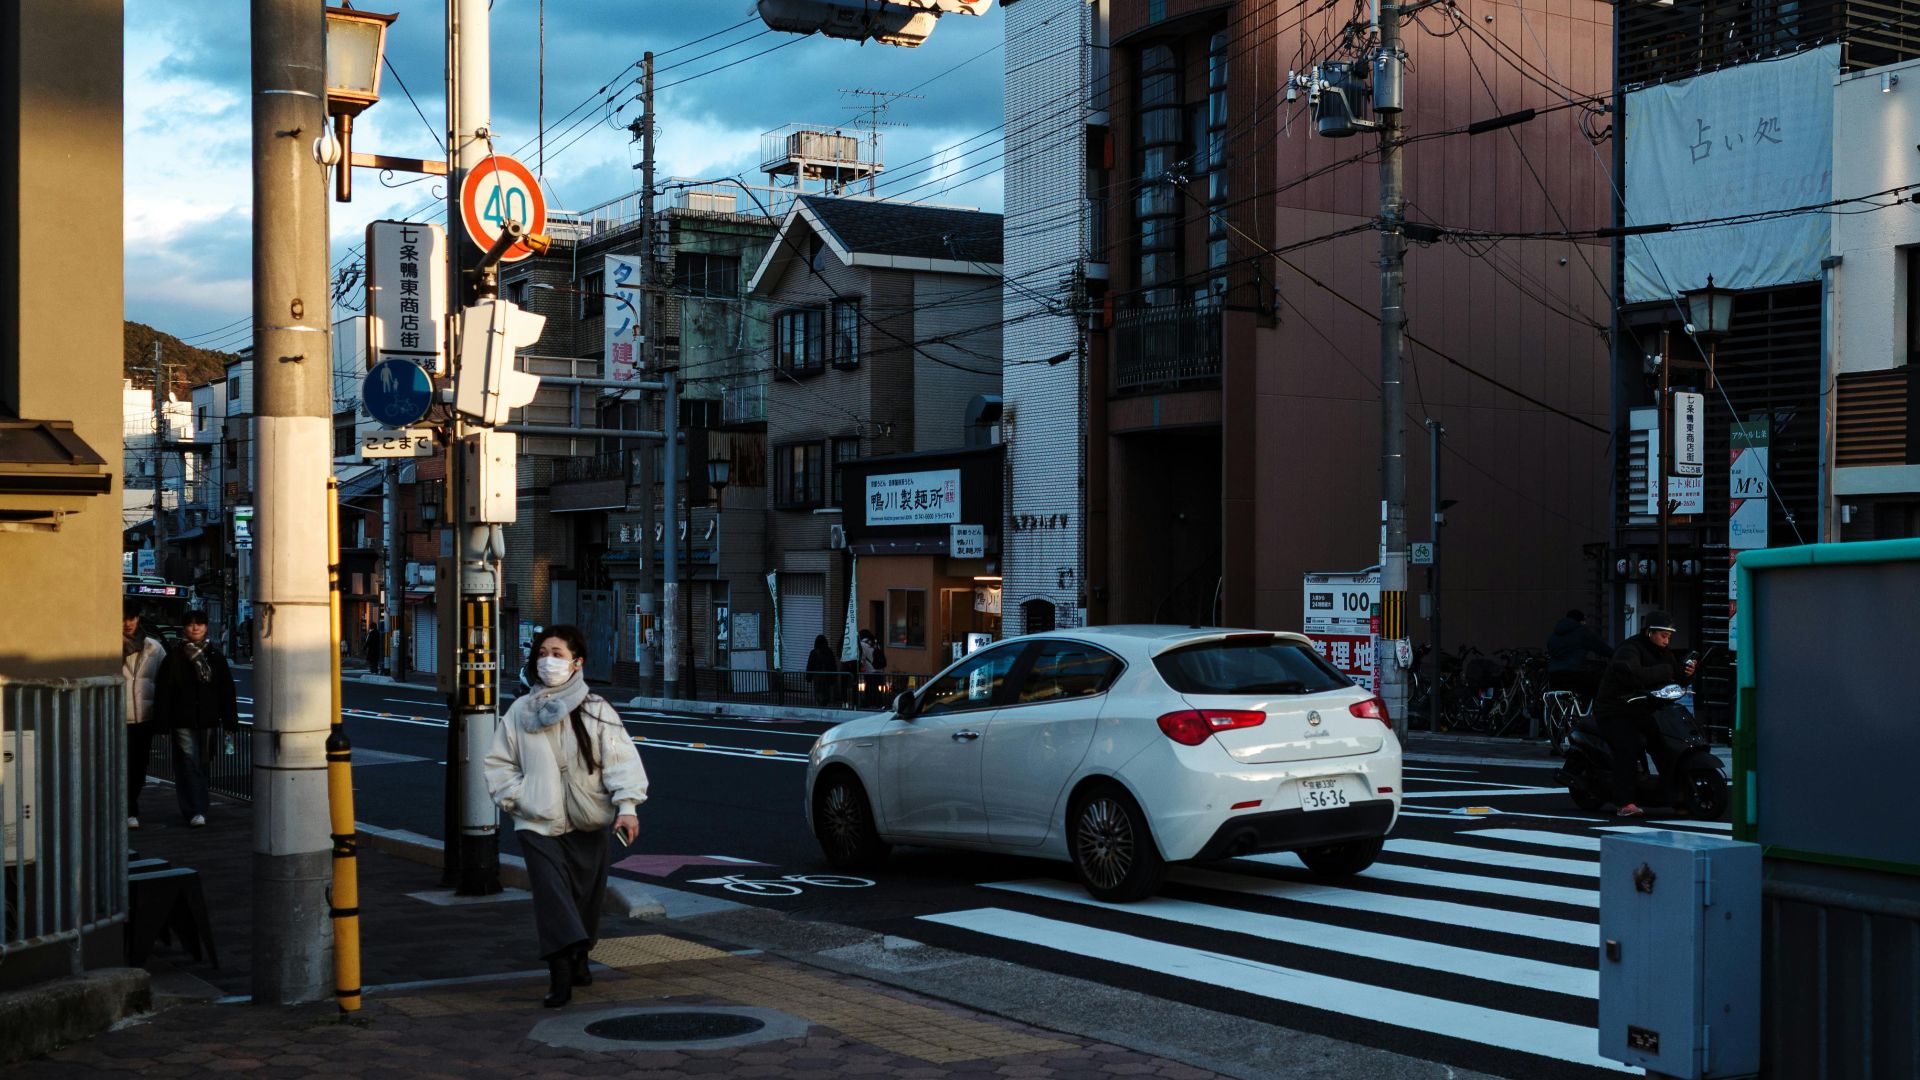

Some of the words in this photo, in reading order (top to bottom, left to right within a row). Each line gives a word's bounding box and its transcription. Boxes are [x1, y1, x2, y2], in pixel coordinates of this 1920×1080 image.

[1688, 116, 1783, 165] 占い処
[483, 184, 527, 227] 40
[399, 226, 420, 349] 七条鴨東商店街
[1685, 394, 1696, 462] 七条鴨東商店街
[365, 435, 430, 451] ここまで
[1734, 477, 1764, 494] M's
[870, 486, 944, 512] 鴨川製麺所
[957, 547, 982, 555] 製麺所
[1341, 591, 1370, 612] 100
